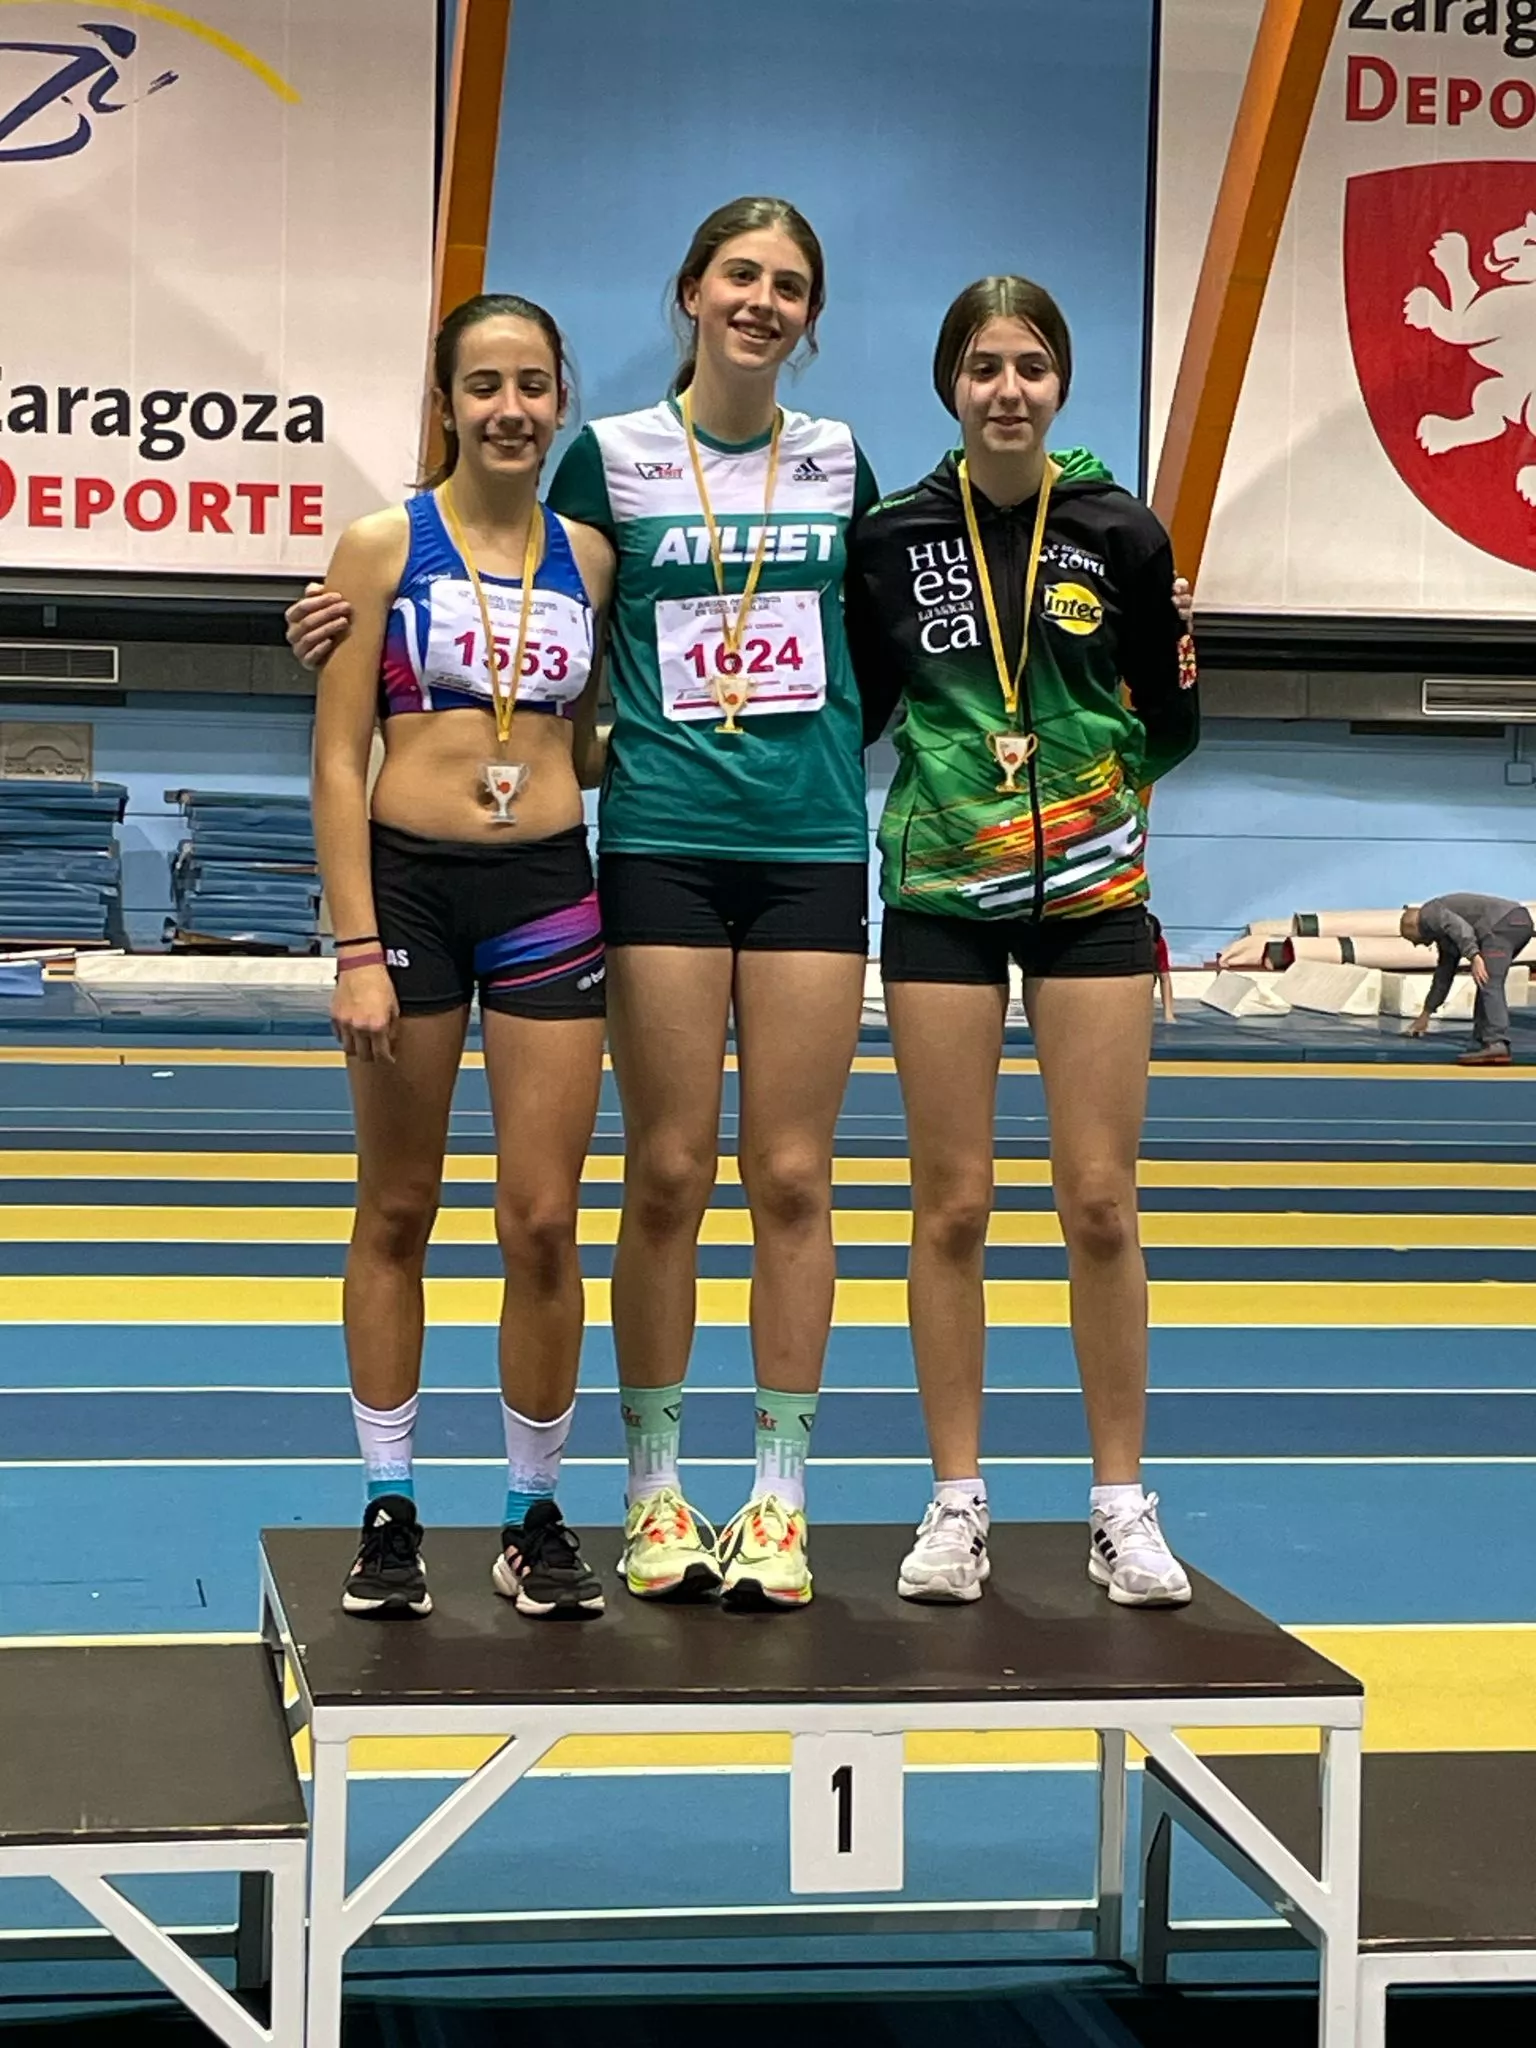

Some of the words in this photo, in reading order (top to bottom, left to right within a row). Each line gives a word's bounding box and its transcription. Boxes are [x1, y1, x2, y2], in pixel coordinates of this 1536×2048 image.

[1346, 55, 1536, 129] DEPO
[0, 366, 324, 461] aragoza
[651, 524, 838, 567] ATLEET
[454, 631, 569, 682] 1553
[684, 636, 803, 678] 1624
[832, 1766, 852, 1853] 1
